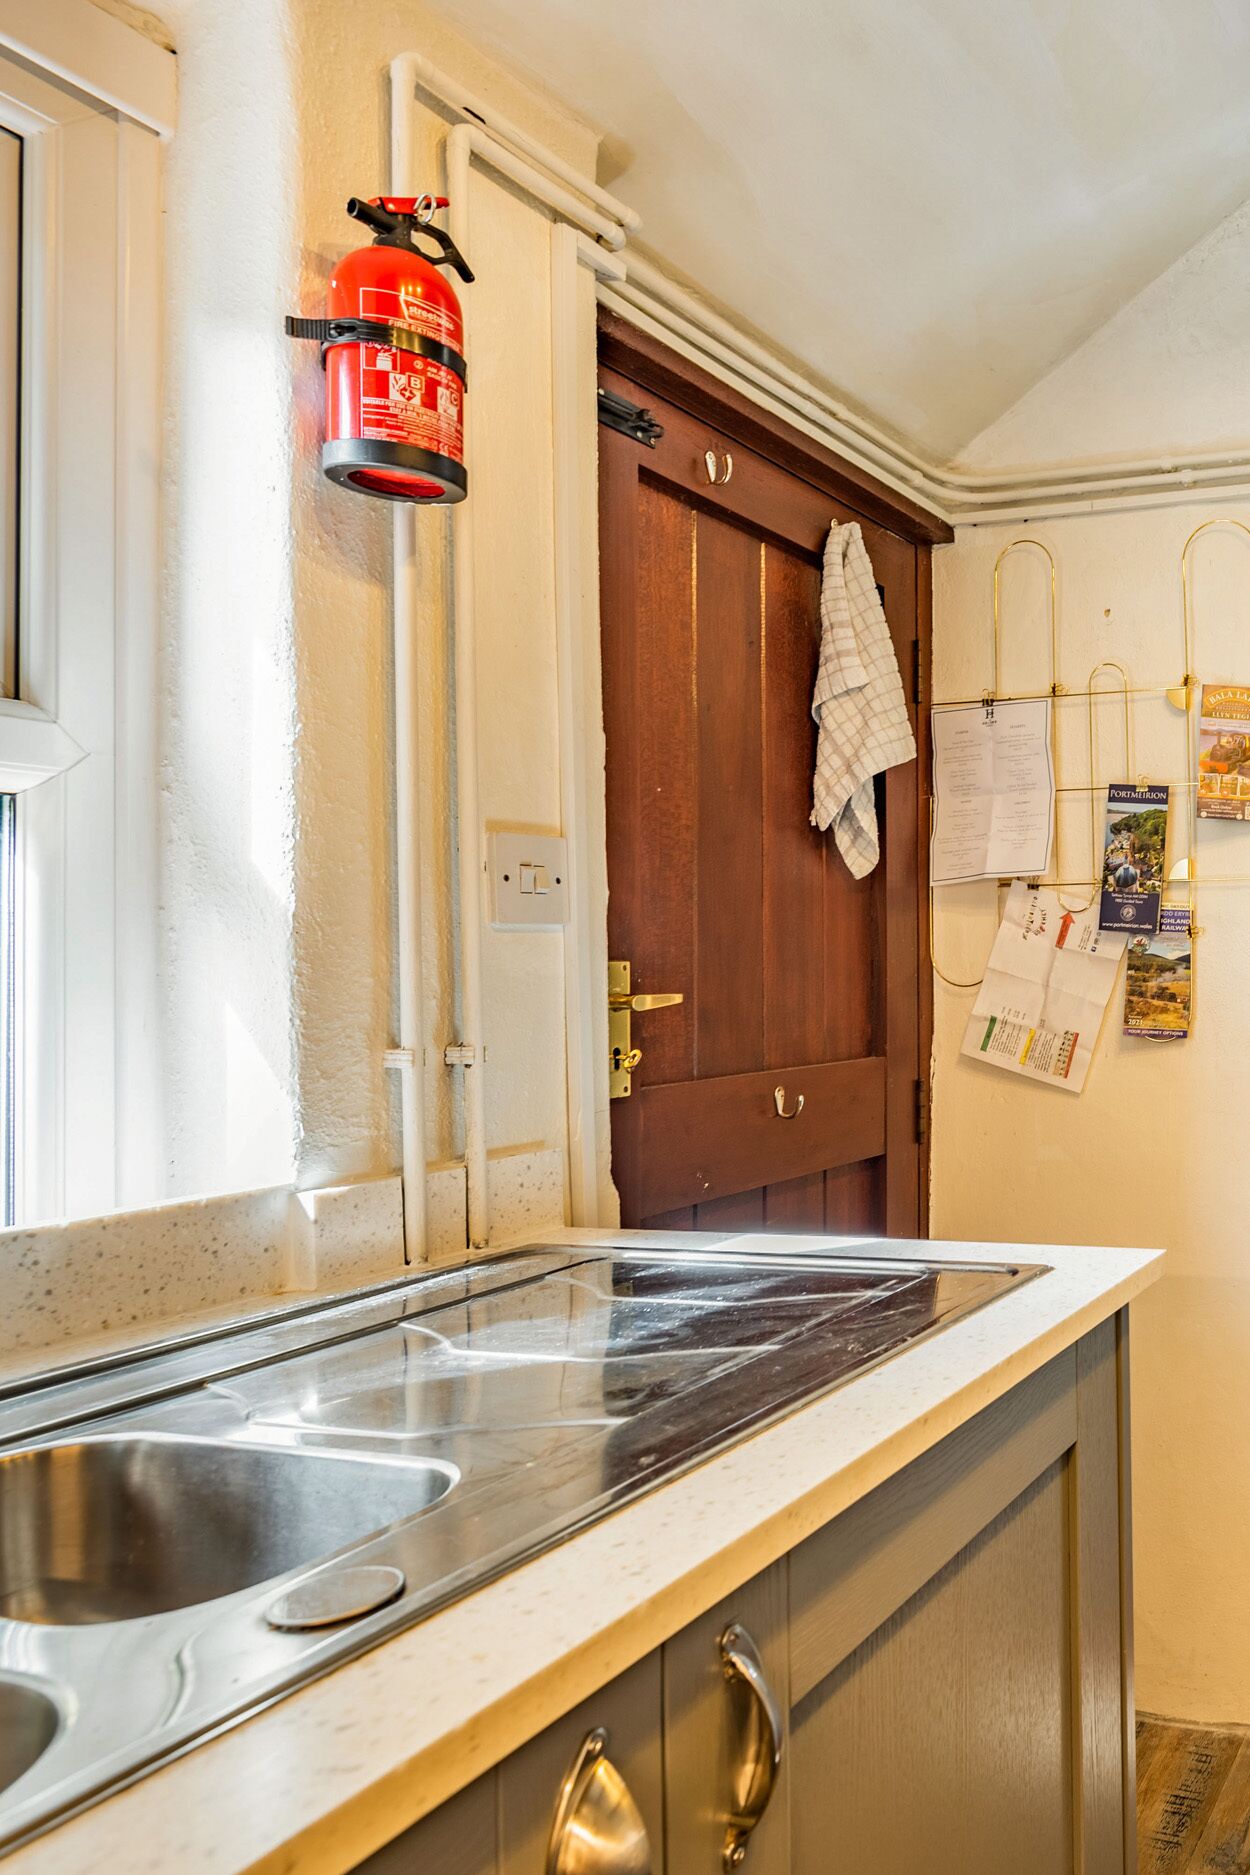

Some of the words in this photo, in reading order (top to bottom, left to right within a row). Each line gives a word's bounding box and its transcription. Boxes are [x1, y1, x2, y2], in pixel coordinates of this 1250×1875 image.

[389, 320, 409, 331] FIRE
[411, 377, 421, 388] B
[1209, 691, 1233, 704] BALA
[1110, 789, 1167, 800] PORTMEIRION
